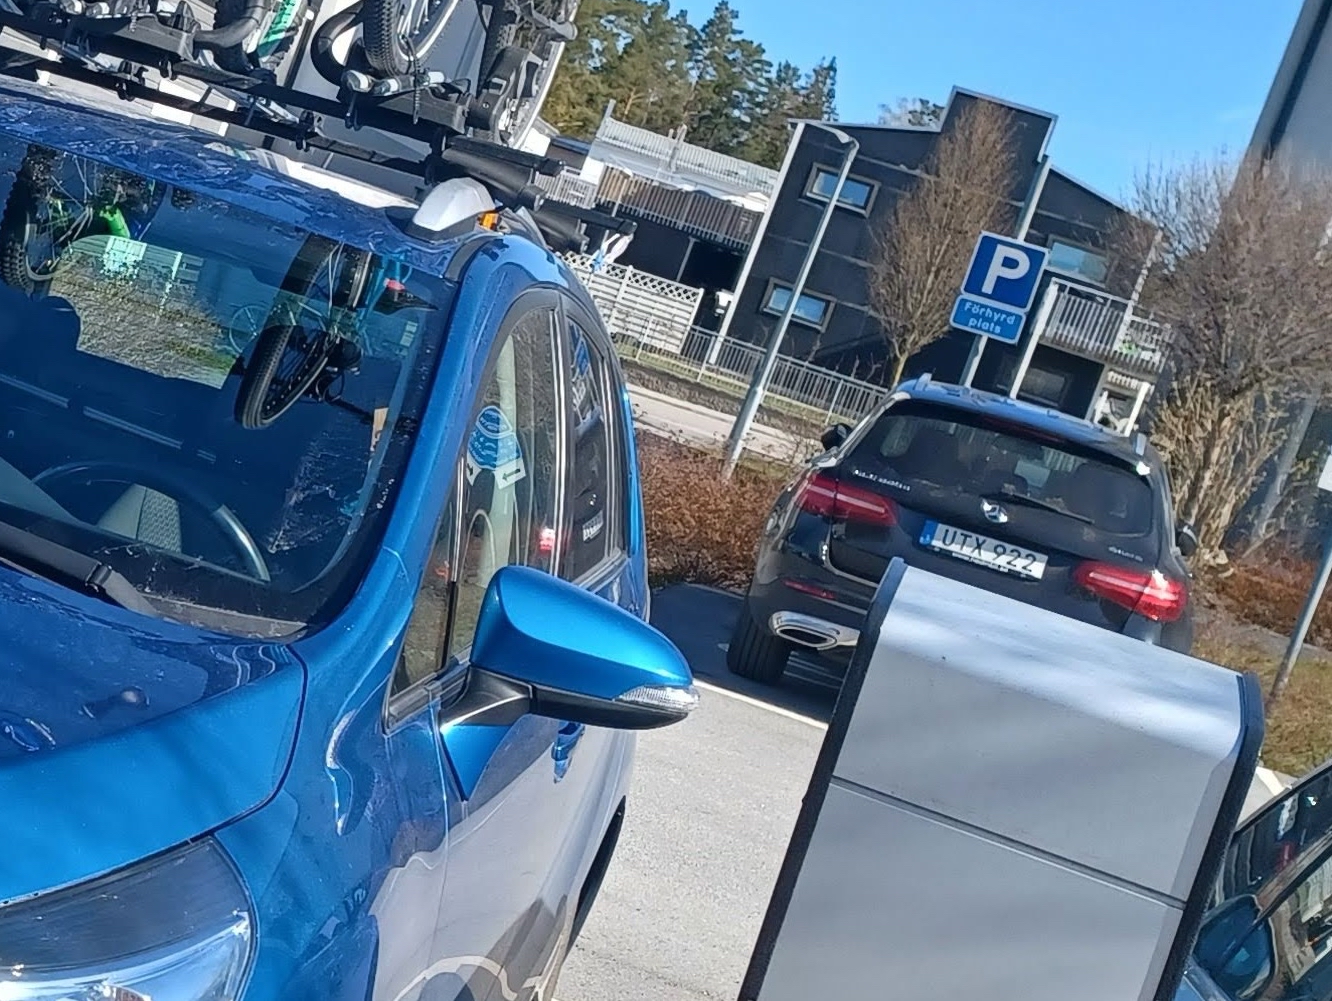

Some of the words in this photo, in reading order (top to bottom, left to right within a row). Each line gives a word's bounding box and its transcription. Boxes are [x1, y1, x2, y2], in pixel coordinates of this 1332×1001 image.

[981, 243, 1031, 295] P
[964, 301, 1016, 325] Förhyrd
[968, 317, 1002, 334] plats
[942, 529, 987, 557] UTX
[993, 544, 1036, 573] 922
